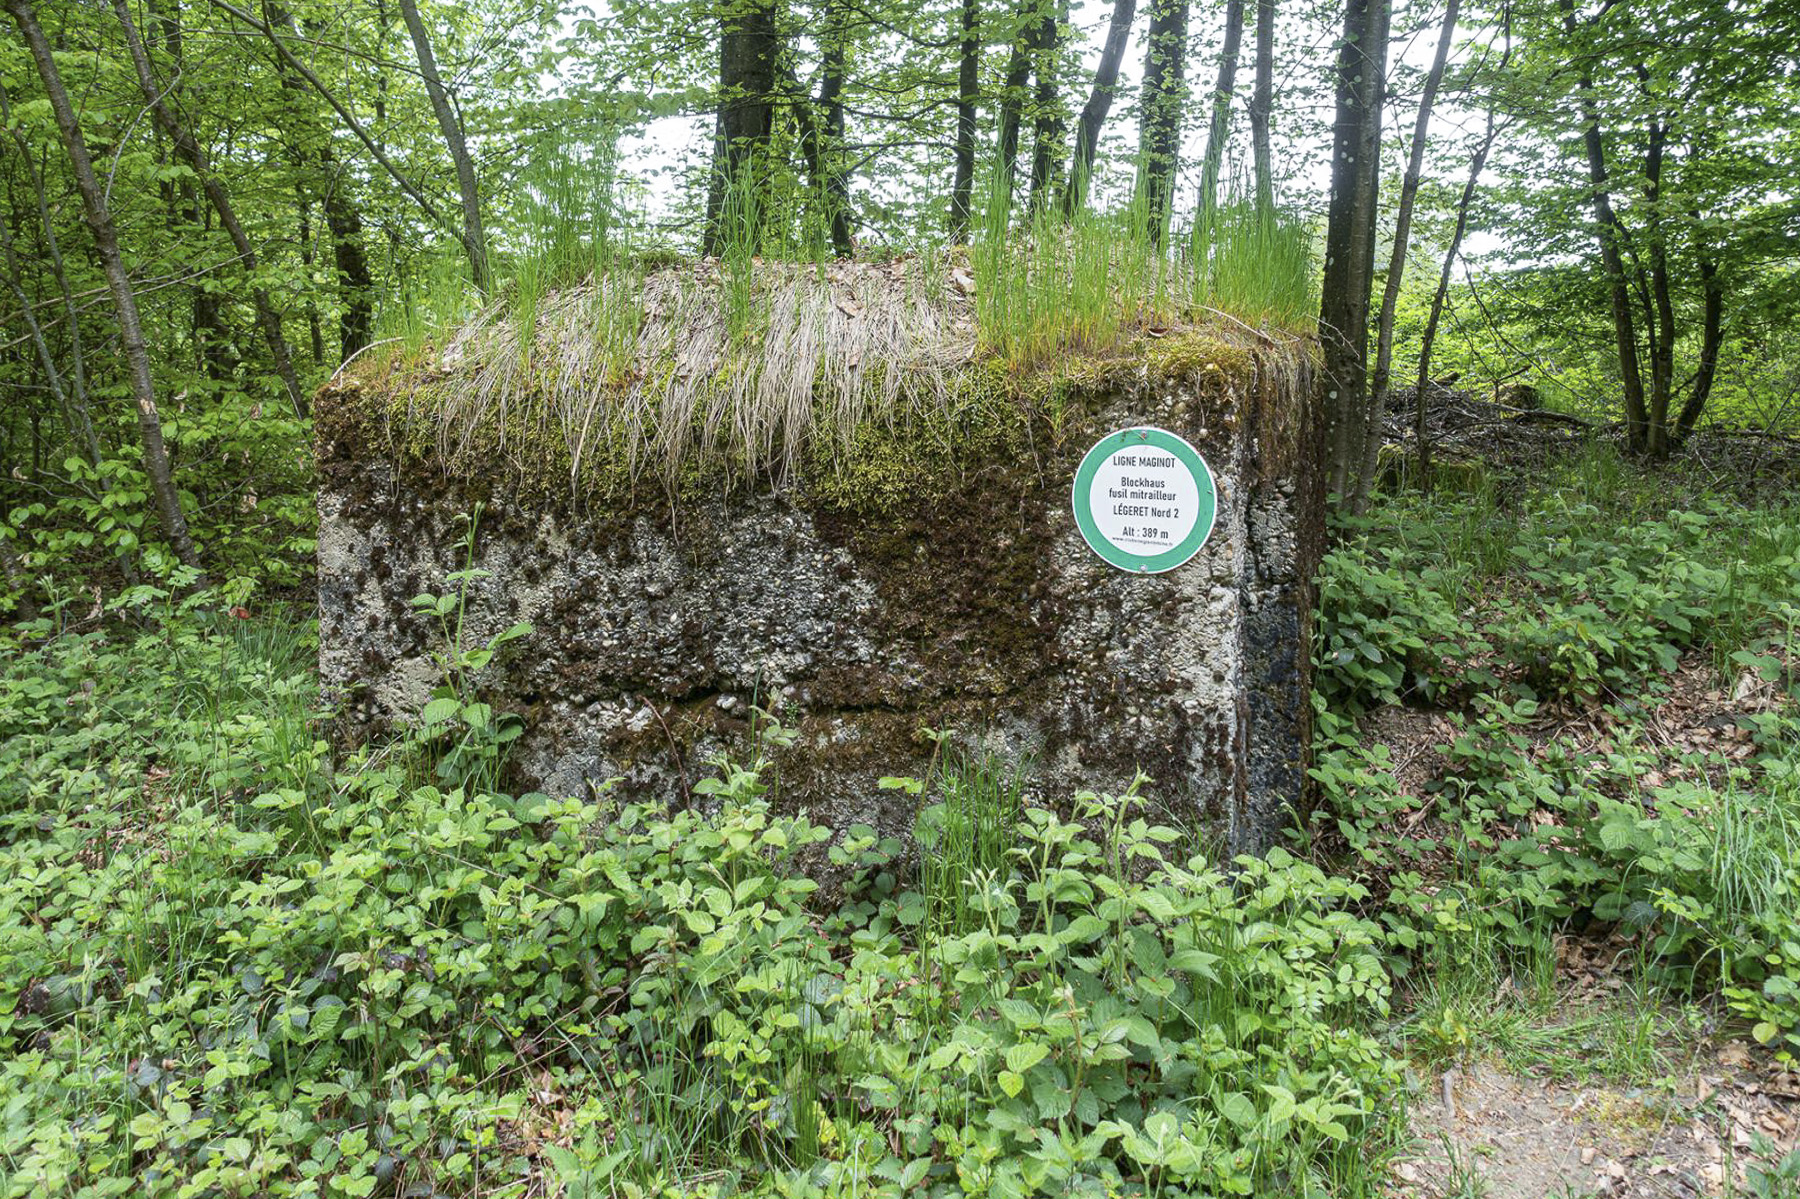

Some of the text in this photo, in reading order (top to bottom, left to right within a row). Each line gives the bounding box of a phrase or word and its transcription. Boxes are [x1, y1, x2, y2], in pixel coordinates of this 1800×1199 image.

[1113, 456, 1175, 467] LIGNE MAGINOT
[1121, 477, 1165, 487] Blockhaus
[1109, 488, 1176, 500] fusil mitrailleur
[1113, 503, 1179, 518] LÉGERET Nord 2
[1123, 526, 1135, 536] Alt
[1142, 528, 1158, 538] 389
